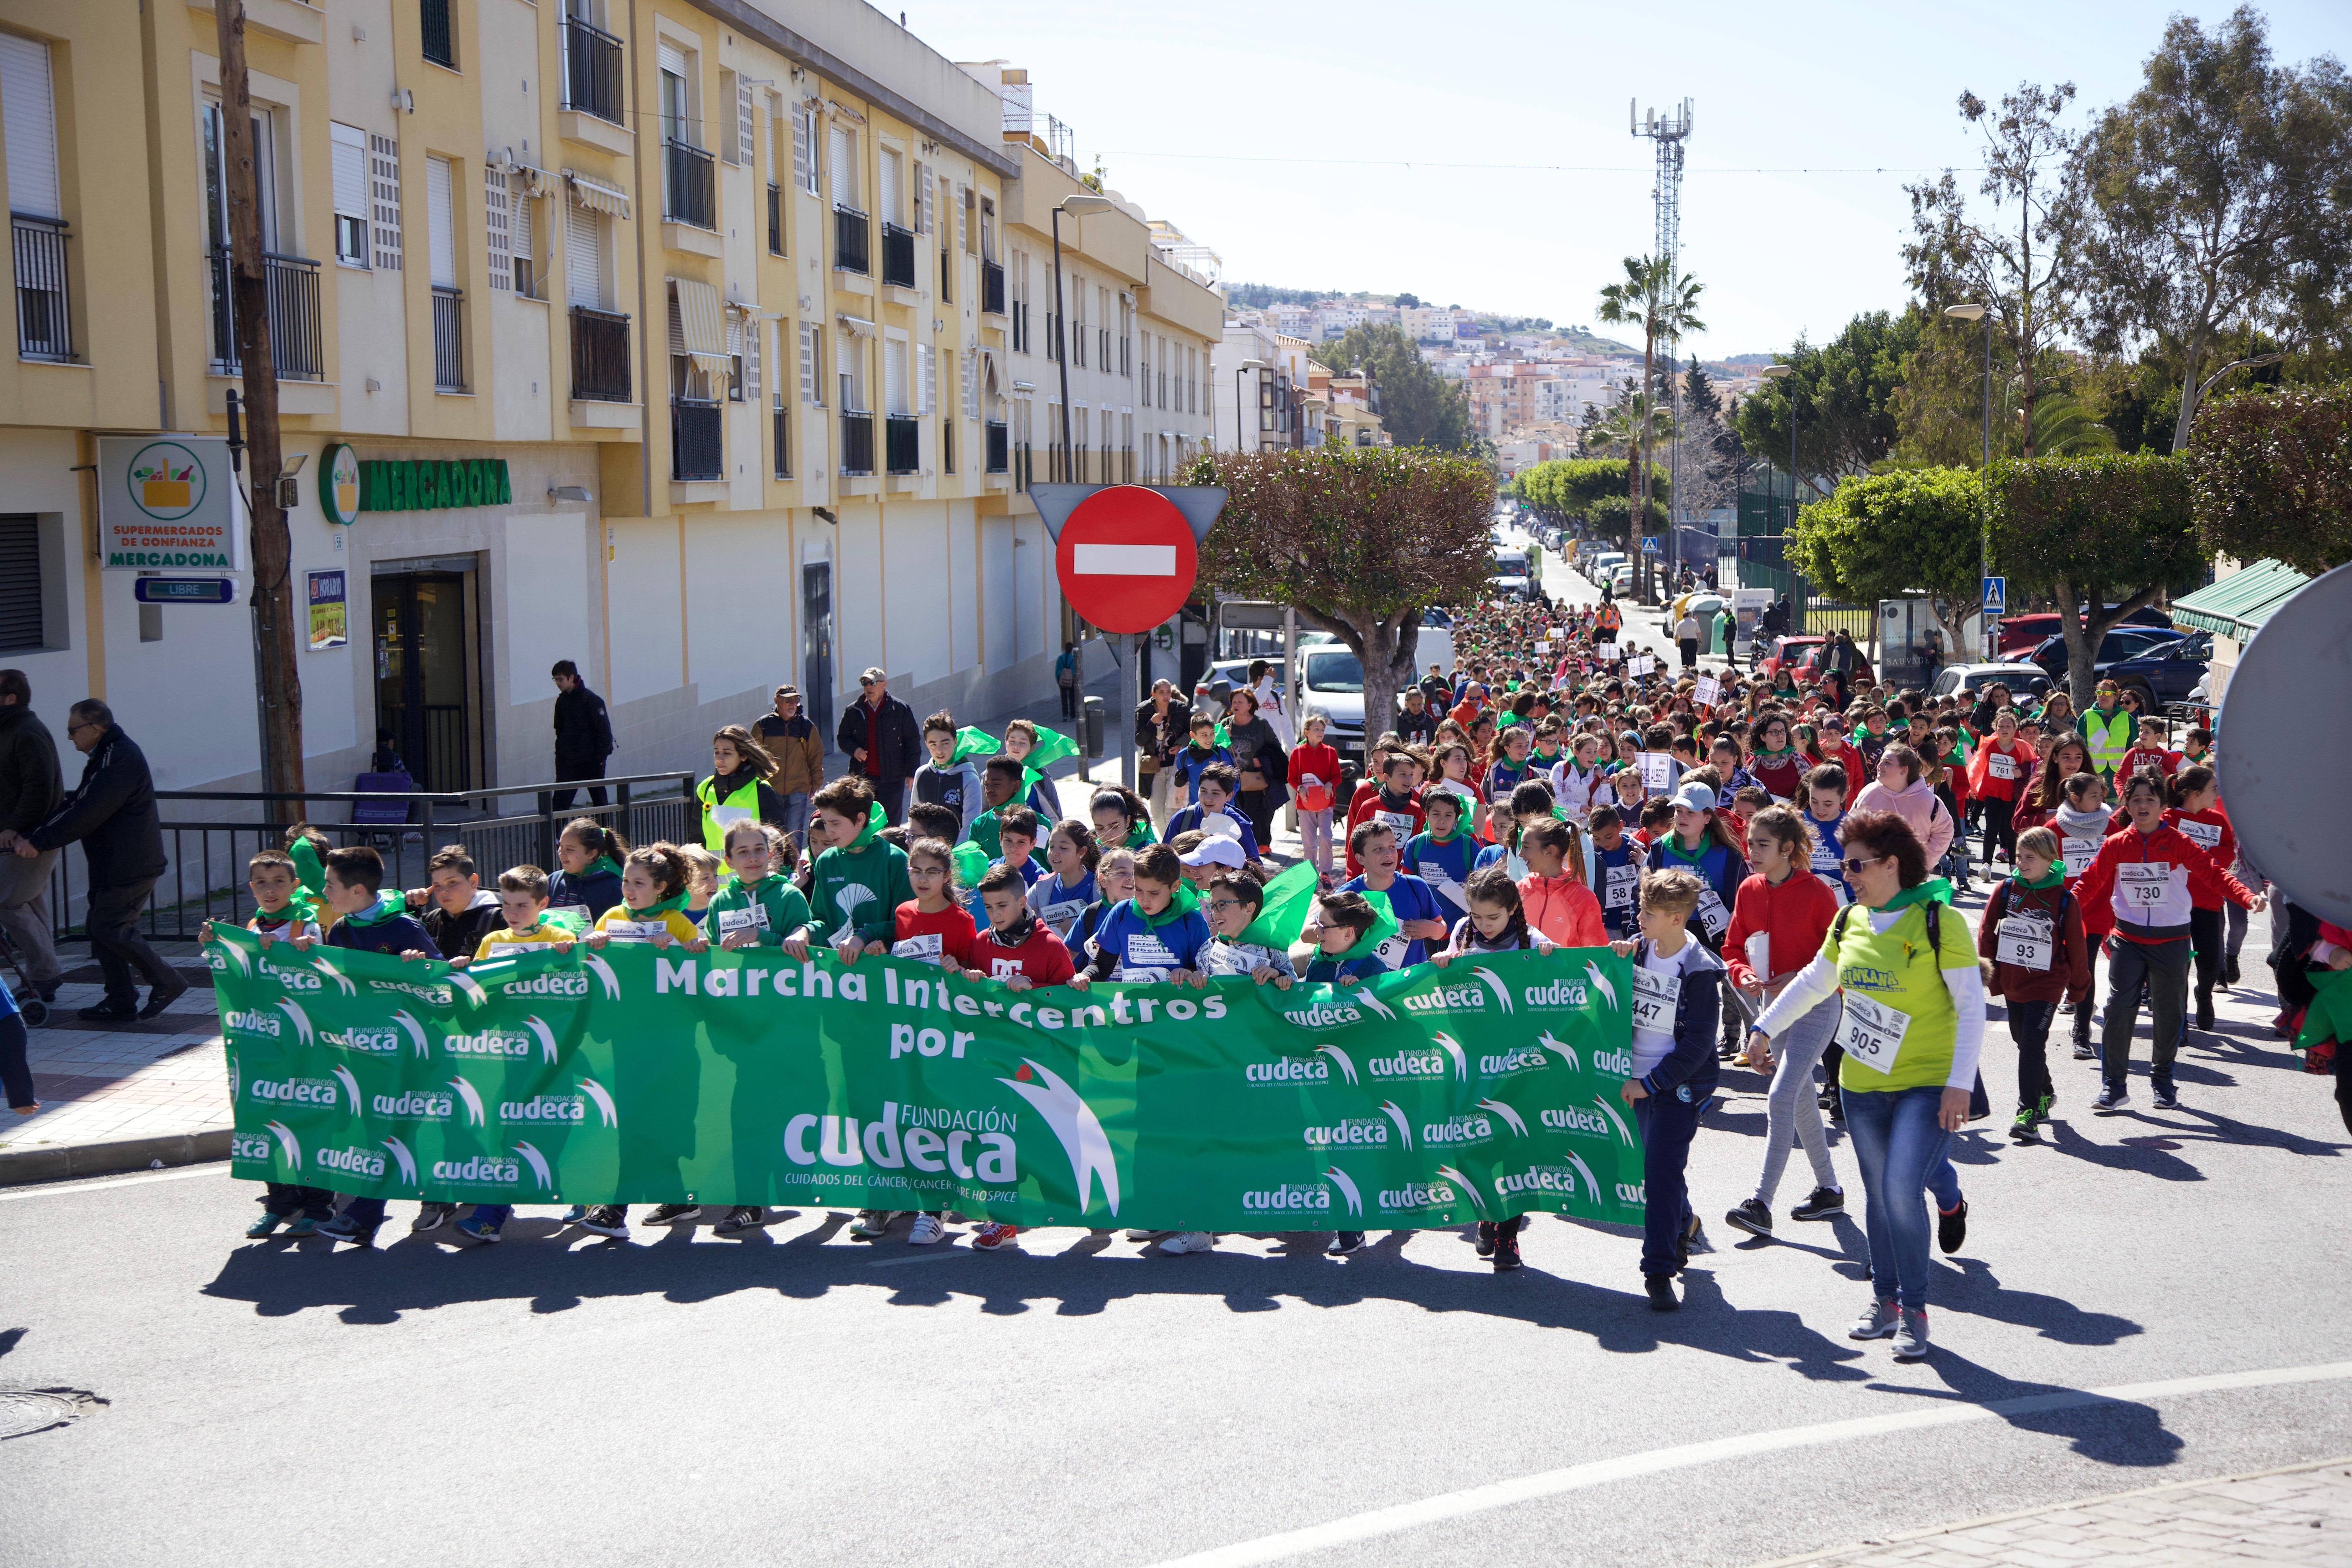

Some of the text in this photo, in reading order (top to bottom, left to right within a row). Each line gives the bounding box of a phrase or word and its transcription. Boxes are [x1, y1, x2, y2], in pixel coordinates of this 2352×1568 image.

[370, 459, 512, 512] MERCADONA
[113, 526, 222, 535] SUPERMERCADOS
[121, 537, 215, 547] DE CONFIANZA
[110, 552, 228, 566] MERCADONA
[170, 585, 199, 594] LIBRE
[319, 577, 341, 597] HORARIO
[1887, 657, 1930, 665] SAUVAGE
[1612, 887, 1626, 899] 58
[2135, 887, 2160, 899] 730
[722, 918, 748, 927] cudeca
[1702, 914, 1717, 929] 80
[2003, 924, 2027, 934] cudeca
[892, 947, 914, 955] cudeca
[1213, 951, 1239, 966] cudeca
[2017, 944, 2035, 958] 93
[277, 965, 319, 976] FUNDACIÓN
[548, 970, 588, 978] FUNDACIÓN
[503, 973, 588, 995] cudeca
[1442, 981, 1481, 992] FUNDACIÓN
[1560, 978, 1587, 987] FUNDACIÓN
[369, 980, 453, 1004] cudeca
[656, 957, 1228, 1029] Marcha Intercentros
[1403, 986, 1484, 1009] cudeca
[1525, 978, 1588, 1005] cudeca
[1636, 993, 1660, 1002] INTERCENTROS
[1319, 1000, 1355, 1010] FUNDACIÓN
[1632, 1000, 1661, 1020] 447
[1847, 998, 1871, 1017] cudeca
[225, 1007, 280, 1037] cudeca
[1284, 1003, 1362, 1026] cudeca
[319, 1027, 398, 1050] cudeca
[489, 1029, 530, 1039] FUNDACIÓN
[890, 1023, 975, 1060] por
[1850, 1027, 1882, 1055] 905
[444, 1029, 529, 1055] cudeca
[1288, 1055, 1326, 1064] FUNDACIÓN
[1405, 1047, 1442, 1057] FUNDACIÓN
[1246, 1056, 1328, 1081] cudeca
[1369, 1050, 1444, 1075] cudeca
[1480, 1048, 1548, 1074] cudeca
[296, 1077, 338, 1087] FUNDACIÓN
[252, 1078, 337, 1104] cudeca
[411, 1091, 453, 1099] FUNDACIÓN
[542, 1094, 585, 1103] FUNDACIÓN
[373, 1090, 453, 1116] cudeca
[500, 1095, 585, 1119] cudeca
[1452, 1112, 1487, 1123] FUNDACIÓN
[1574, 1106, 1603, 1117] FUNDACIÓN
[901, 1106, 1017, 1133] FUNDACIÓN
[1348, 1117, 1387, 1126] FUNDACIÓN
[1540, 1105, 1609, 1134] cudeca
[1304, 1119, 1387, 1144] cudeca
[1423, 1116, 1492, 1142] cudeca
[784, 1101, 1017, 1183] cudeca
[354, 1146, 386, 1159] FUNDACIÓN
[317, 1146, 386, 1176] cudeca
[480, 1156, 519, 1165] FUNDACIÓN
[433, 1156, 519, 1181] cudeca
[1537, 1164, 1573, 1174] FUNDACIÓN
[1288, 1181, 1330, 1191] FUNDACIÓN
[1411, 1180, 1449, 1190] FUNDACIÓN
[1495, 1165, 1575, 1195] cudeca
[784, 1173, 840, 1186] CUIDADOS
[844, 1174, 863, 1186] DEL
[953, 1183, 970, 1199] CARE
[972, 1189, 1018, 1203] HOSPICE
[1243, 1184, 1330, 1209] cudeca
[1379, 1183, 1455, 1209] cudeca
